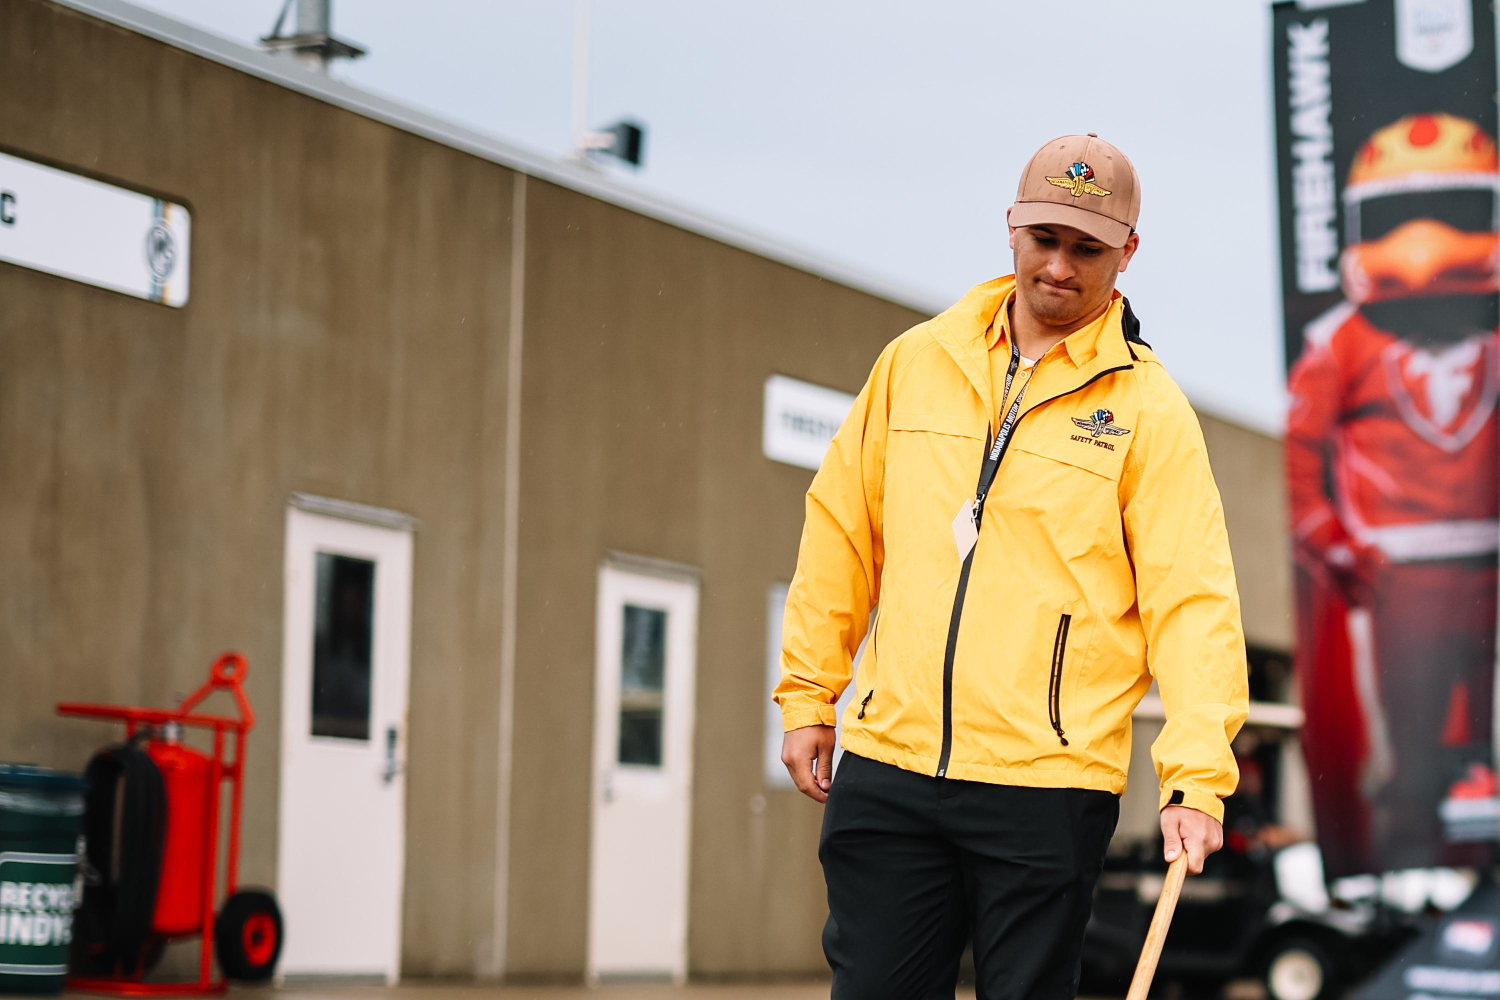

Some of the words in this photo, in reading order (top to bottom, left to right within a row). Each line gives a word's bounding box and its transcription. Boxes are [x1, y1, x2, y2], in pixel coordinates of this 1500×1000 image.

[1287, 18, 1339, 293] FIREHAWK
[989, 422, 1013, 462] INDIANAPOLIS
[1005, 402, 1019, 424] MOTOR
[1070, 434, 1093, 445] SAFETY
[1093, 439, 1115, 452] PATROL
